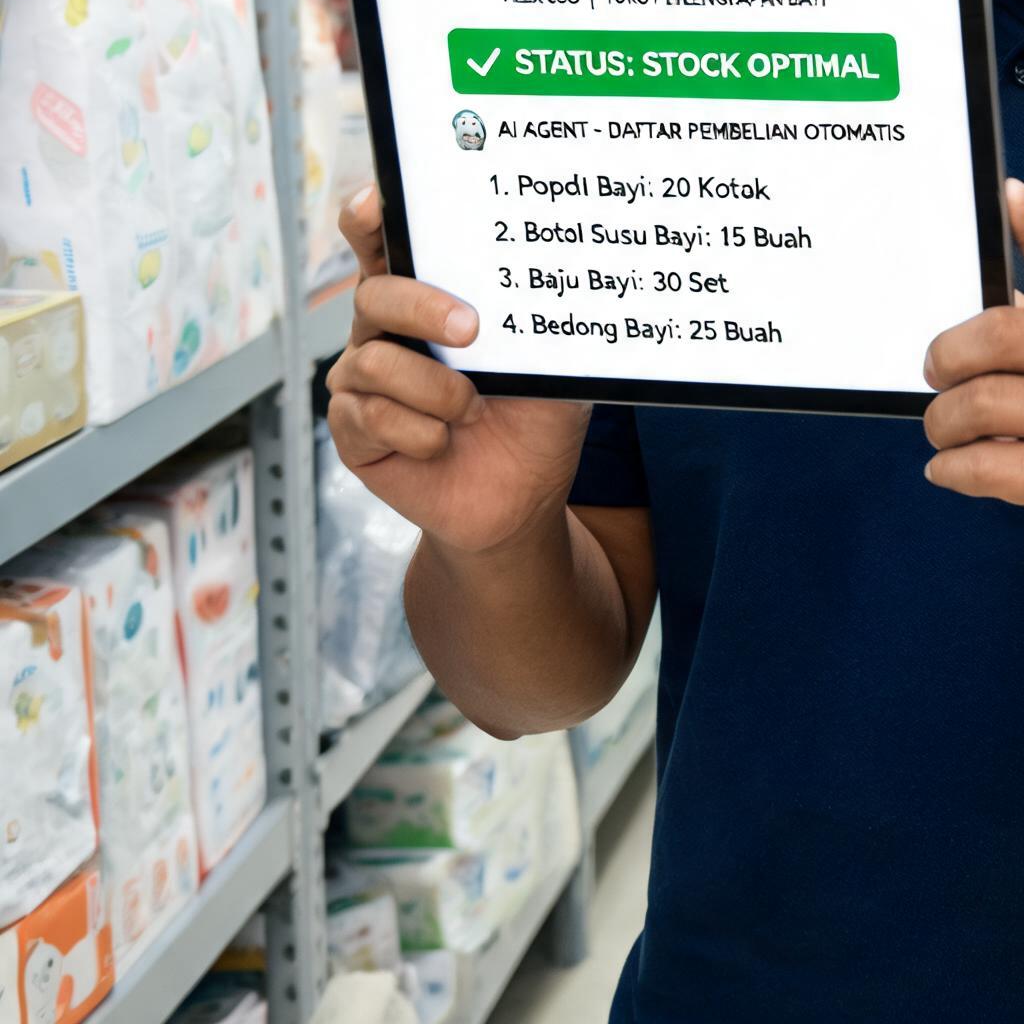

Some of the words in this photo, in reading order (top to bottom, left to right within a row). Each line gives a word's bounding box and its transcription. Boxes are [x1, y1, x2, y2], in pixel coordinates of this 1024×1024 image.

[515, 48, 635, 77] STATUS:
[642, 51, 742, 78] STOCK
[747, 52, 880, 79] OPTIMAL
[498, 120, 518, 139] AI
[522, 120, 589, 139] AGENT
[804, 123, 906, 142] OTOMATIS
[489, 174, 509, 196] 1.
[596, 175, 655, 205] Bayi:
[662, 176, 691, 198] 20
[494, 220, 516, 242] 2.
[523, 221, 584, 244] Botol
[591, 223, 647, 246] Susu
[653, 224, 711, 254] Bayi:
[720, 225, 746, 248] 15
[753, 225, 812, 249] Buah
[498, 266, 519, 289] 3.
[528, 267, 580, 298] Baju
[587, 269, 644, 299] Bayi:
[653, 270, 682, 292] 30
[689, 271, 730, 294] Set
[502, 313, 524, 334] 4.
[531, 312, 618, 344] Bedong
[624, 317, 682, 345] Bayi:
[689, 319, 718, 341] 25
[723, 320, 783, 343] Buah
